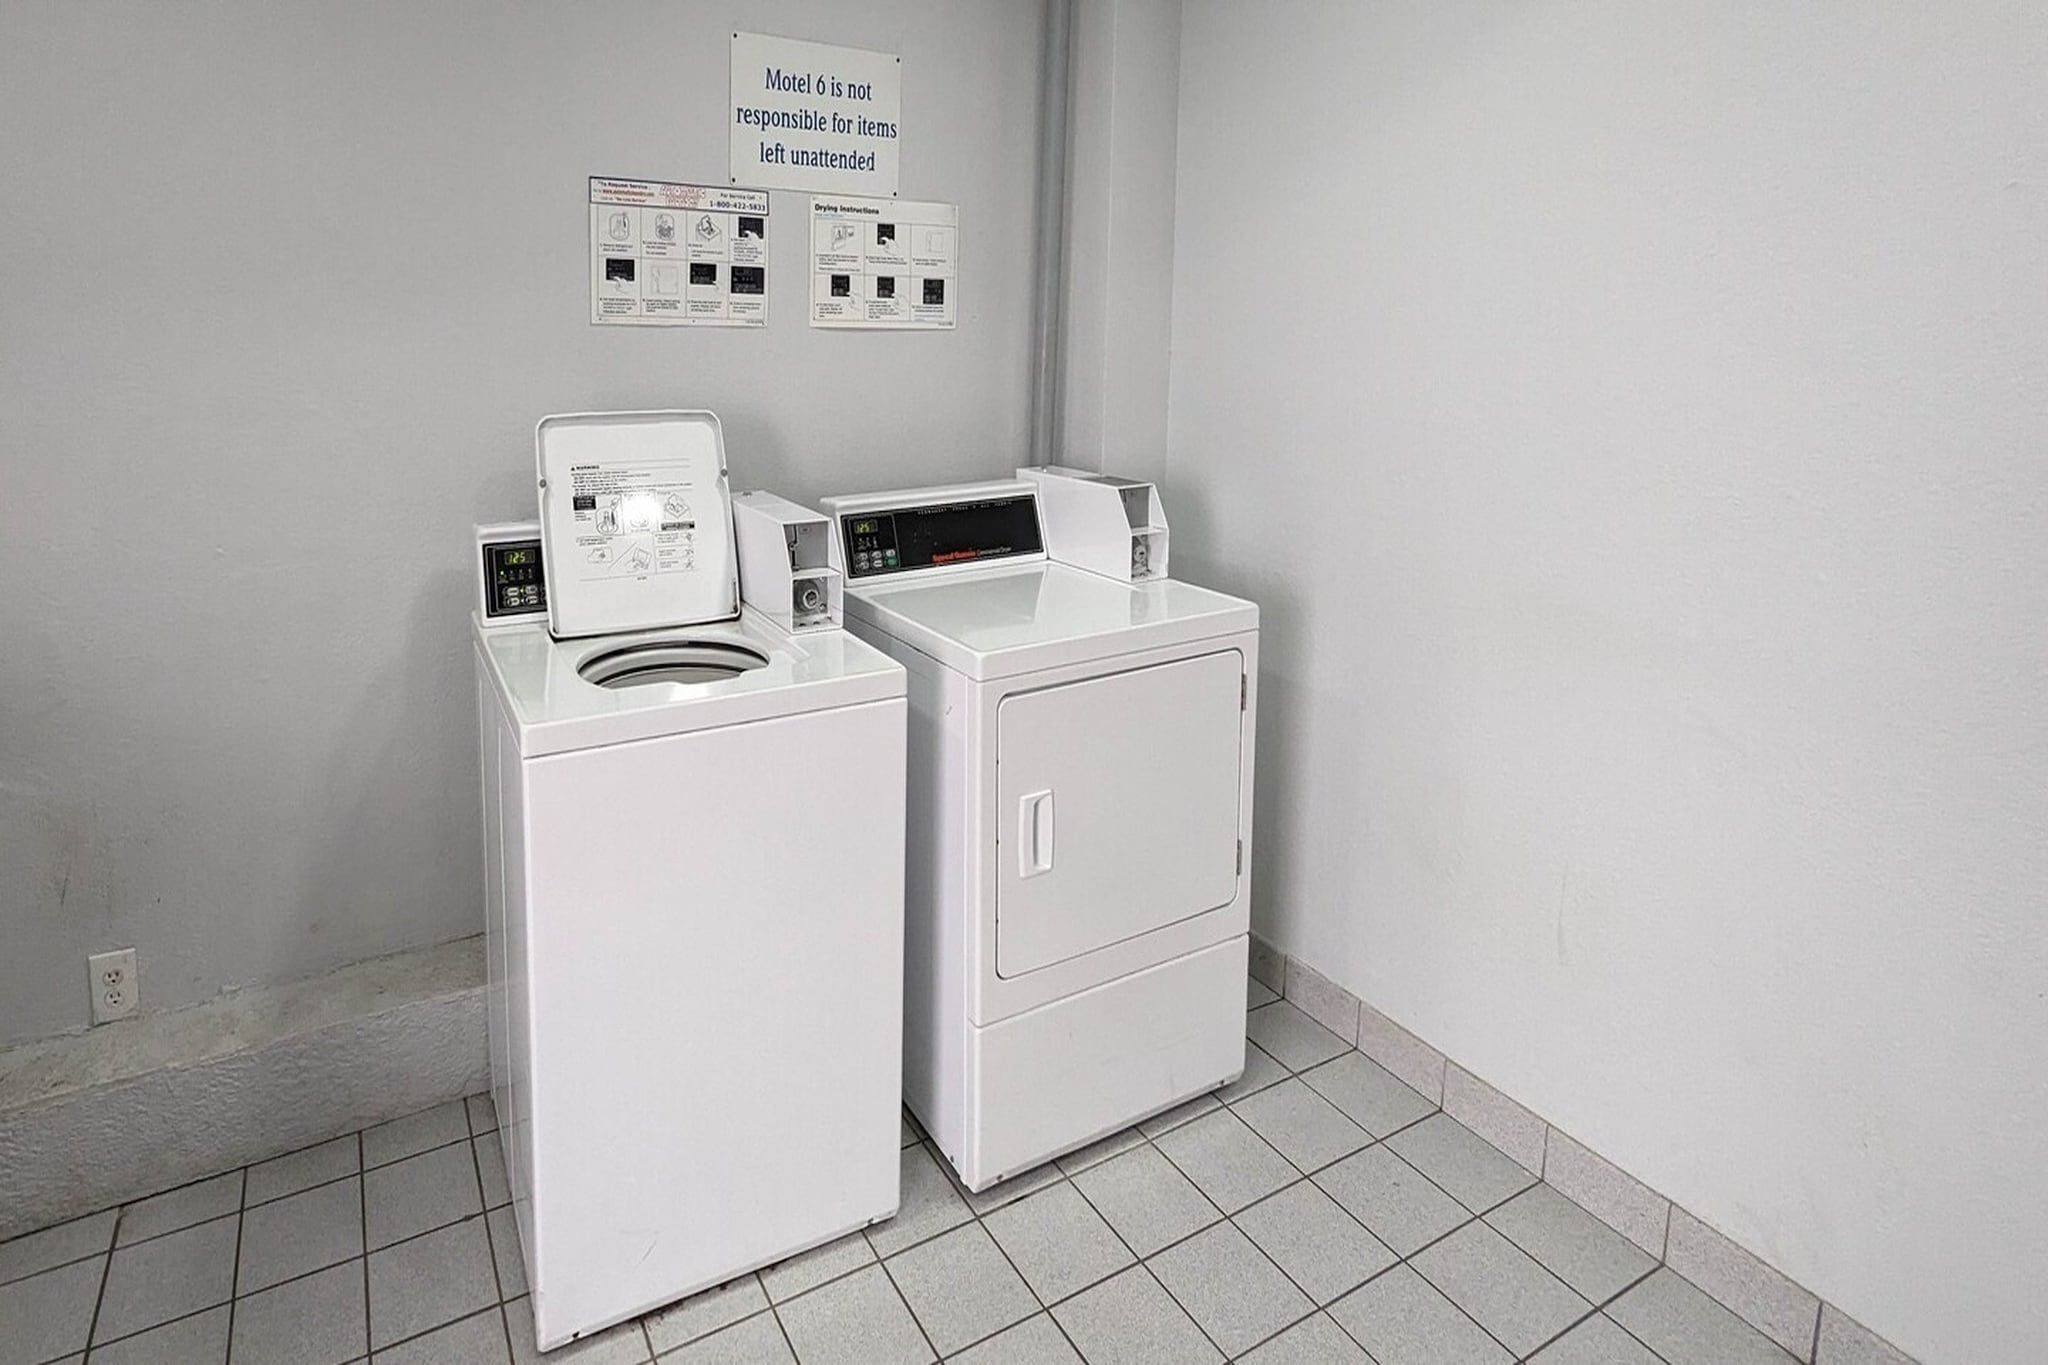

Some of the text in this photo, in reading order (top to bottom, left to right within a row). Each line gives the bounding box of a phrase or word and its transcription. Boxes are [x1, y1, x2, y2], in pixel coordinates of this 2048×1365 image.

[765, 67, 872, 101] Motel 6 is not
[736, 107, 898, 139] responsible for items
[760, 142, 876, 171] left unattended
[814, 203, 880, 215] Drying Instructions
[508, 551, 526, 564] 125
